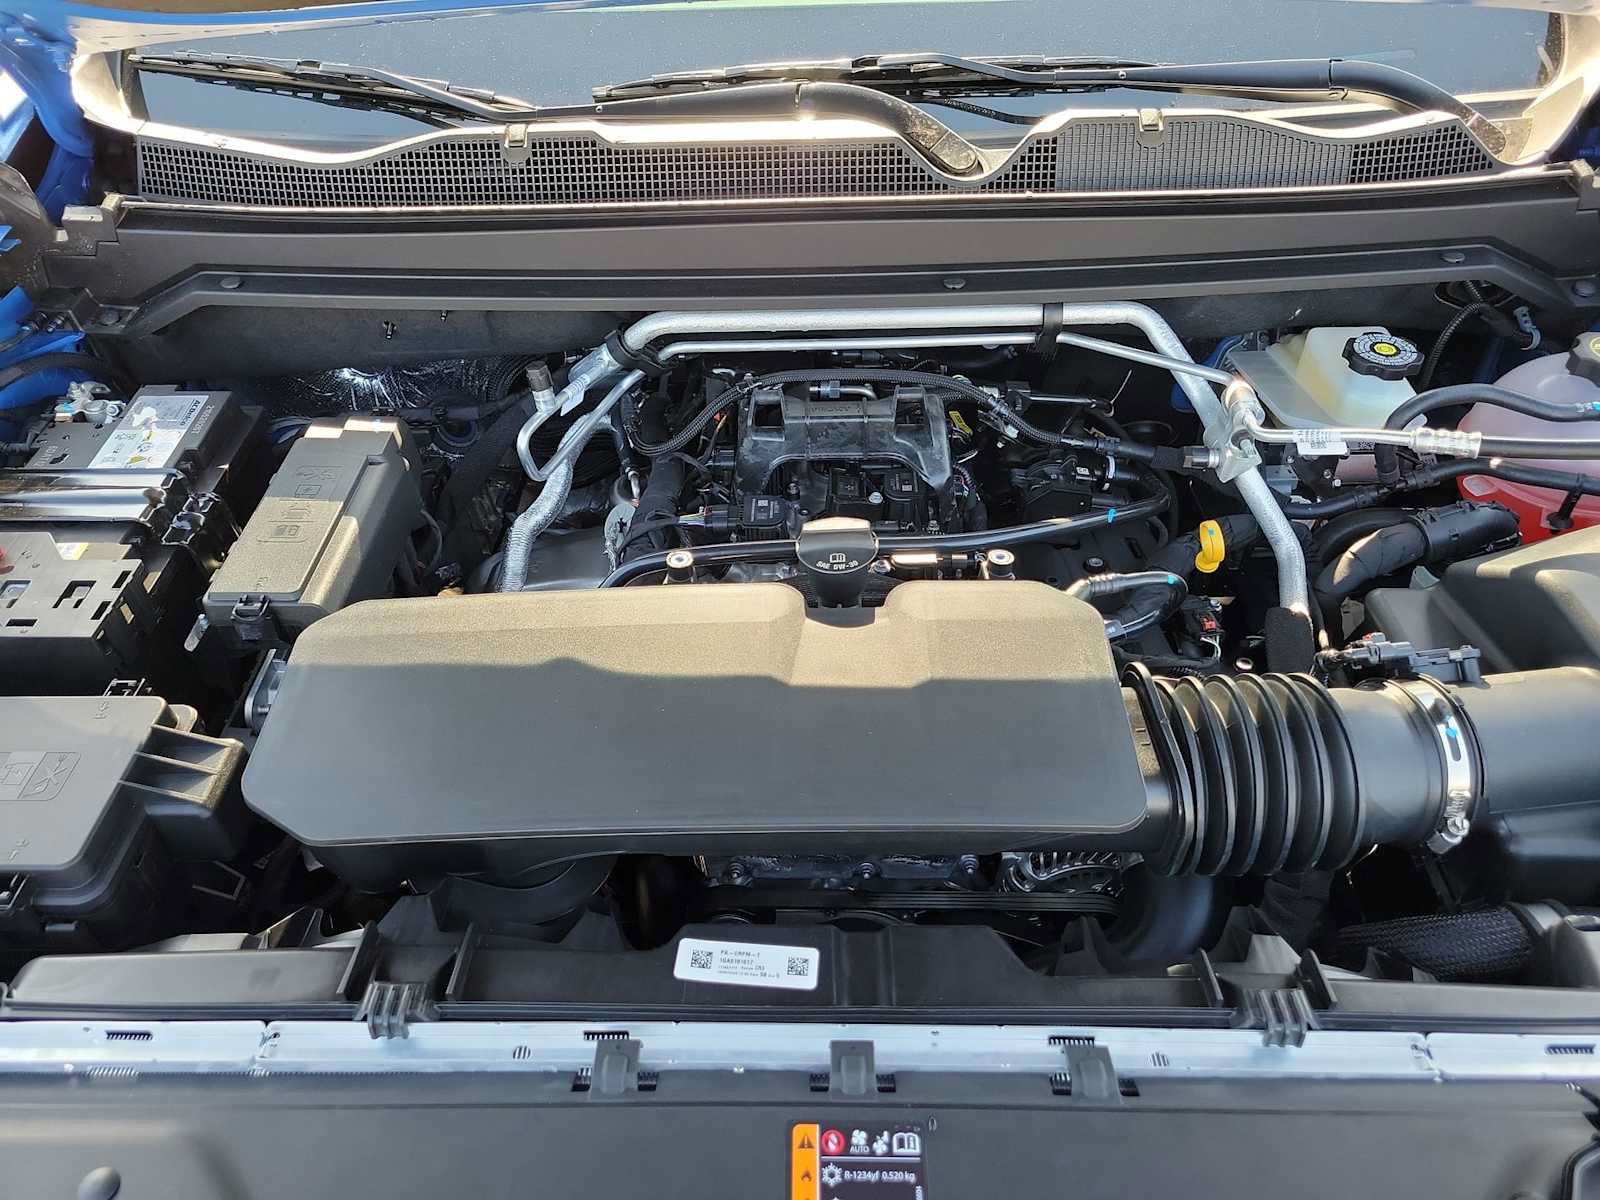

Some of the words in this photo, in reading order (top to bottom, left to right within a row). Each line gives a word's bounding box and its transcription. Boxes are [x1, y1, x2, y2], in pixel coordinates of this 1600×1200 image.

[180, 399, 201, 426] ACDelco
[816, 560, 831, 569] SAE
[849, 1145, 870, 1153] AUTO
[844, 1170, 880, 1182] R-1234yf
[881, 1170, 904, 1181] 0.520
[904, 1170, 916, 1183] kg
